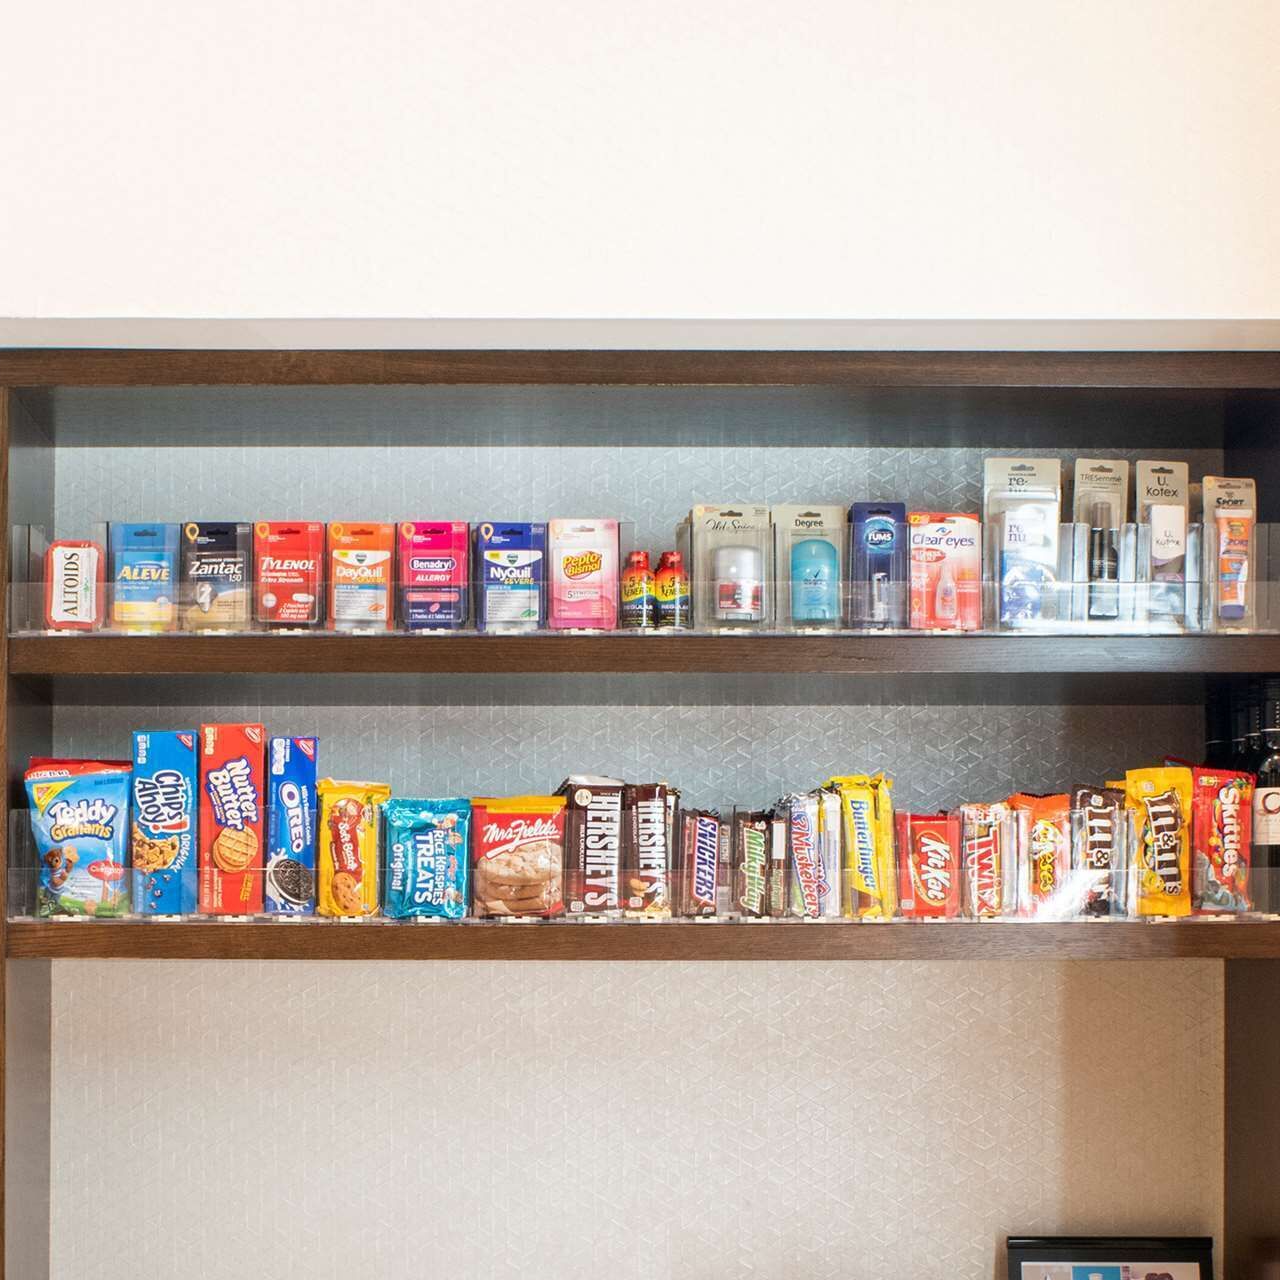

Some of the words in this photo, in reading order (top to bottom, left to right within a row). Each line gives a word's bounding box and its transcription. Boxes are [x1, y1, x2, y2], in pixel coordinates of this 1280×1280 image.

[1146, 487, 1179, 497] Kotex
[795, 519, 824, 529] Degree
[868, 532, 892, 541] TUMS
[912, 533, 943, 546] Clear
[946, 536, 975, 550] eyes
[117, 566, 170, 581] ALEVE
[189, 560, 243, 575] Zantac
[261, 557, 315, 571] TYLENOL
[336, 566, 384, 579] DayQuil
[413, 560, 452, 571] Benadryl
[415, 574, 451, 582] ALLERGY
[489, 567, 533, 581] NyQuil
[63, 552, 80, 617] ALTOIDS
[228, 574, 243, 583] 150
[155, 770, 184, 821] Chips
[208, 769, 244, 831] Butter
[226, 757, 257, 822] Nutter
[48, 799, 119, 826] Teddy
[280, 782, 303, 853] OREO
[50, 823, 114, 843] Grahams
[434, 830, 445, 855] RICE
[513, 818, 559, 848] Fields
[851, 800, 877, 890] Butterfinger
[1219, 787, 1241, 876] Skittles
[173, 834, 191, 873] ORIGINAL
[392, 844, 405, 890] original
[695, 819, 717, 902] SNICKERS
[414, 832, 434, 904] TREATS
[432, 855, 447, 905] KRISPIES
[792, 832, 819, 919] Musketeers
[967, 828, 1000, 916] TWIX
